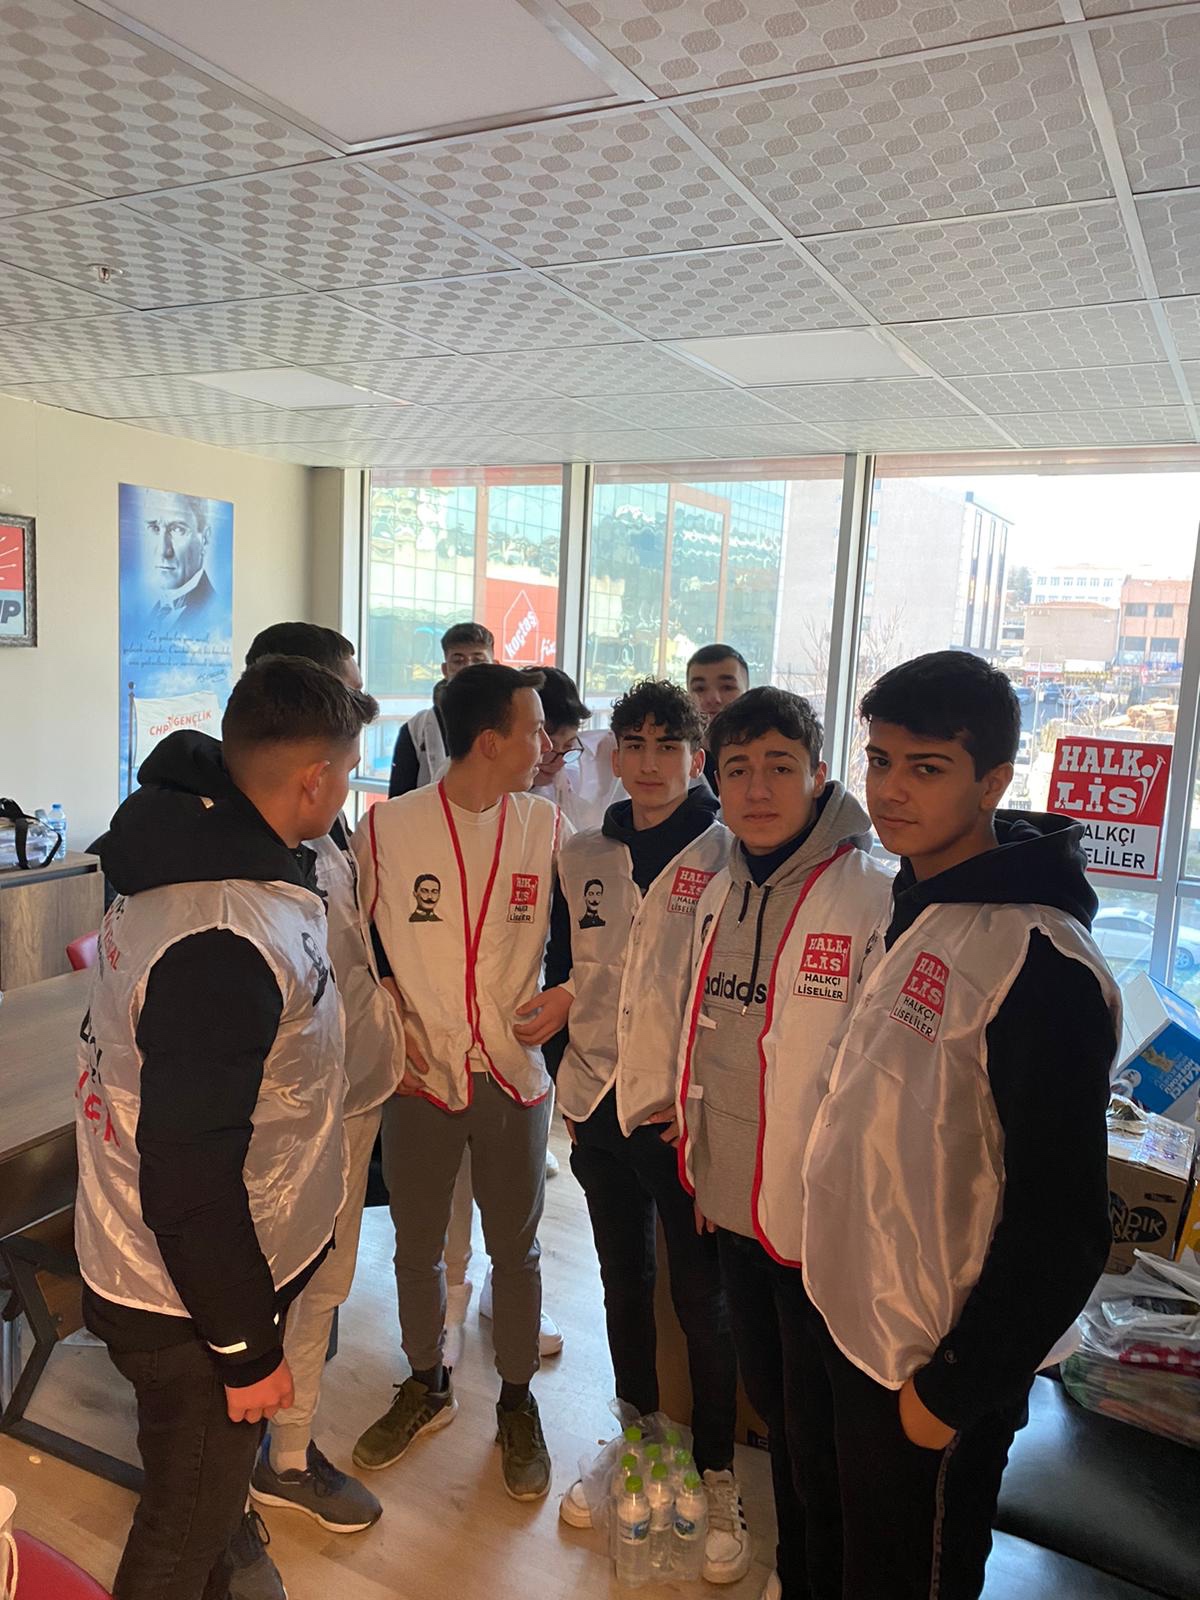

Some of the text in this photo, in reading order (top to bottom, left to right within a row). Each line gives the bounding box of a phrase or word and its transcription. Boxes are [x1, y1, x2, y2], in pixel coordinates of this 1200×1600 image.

[149, 725, 169, 736] CHP
[1054, 777, 1137, 816] LİS
[1083, 824, 1136, 847] ALKÇI
[1084, 847, 1145, 870] ELİLER
[803, 952, 842, 972] LİS
[804, 973, 841, 987] HALKÇI
[907, 976, 943, 1006] LİS
[797, 984, 843, 1000] LİSELİLER
[903, 995, 936, 1022] HALKÇI
[893, 1007, 934, 1038] LİSELİLER
